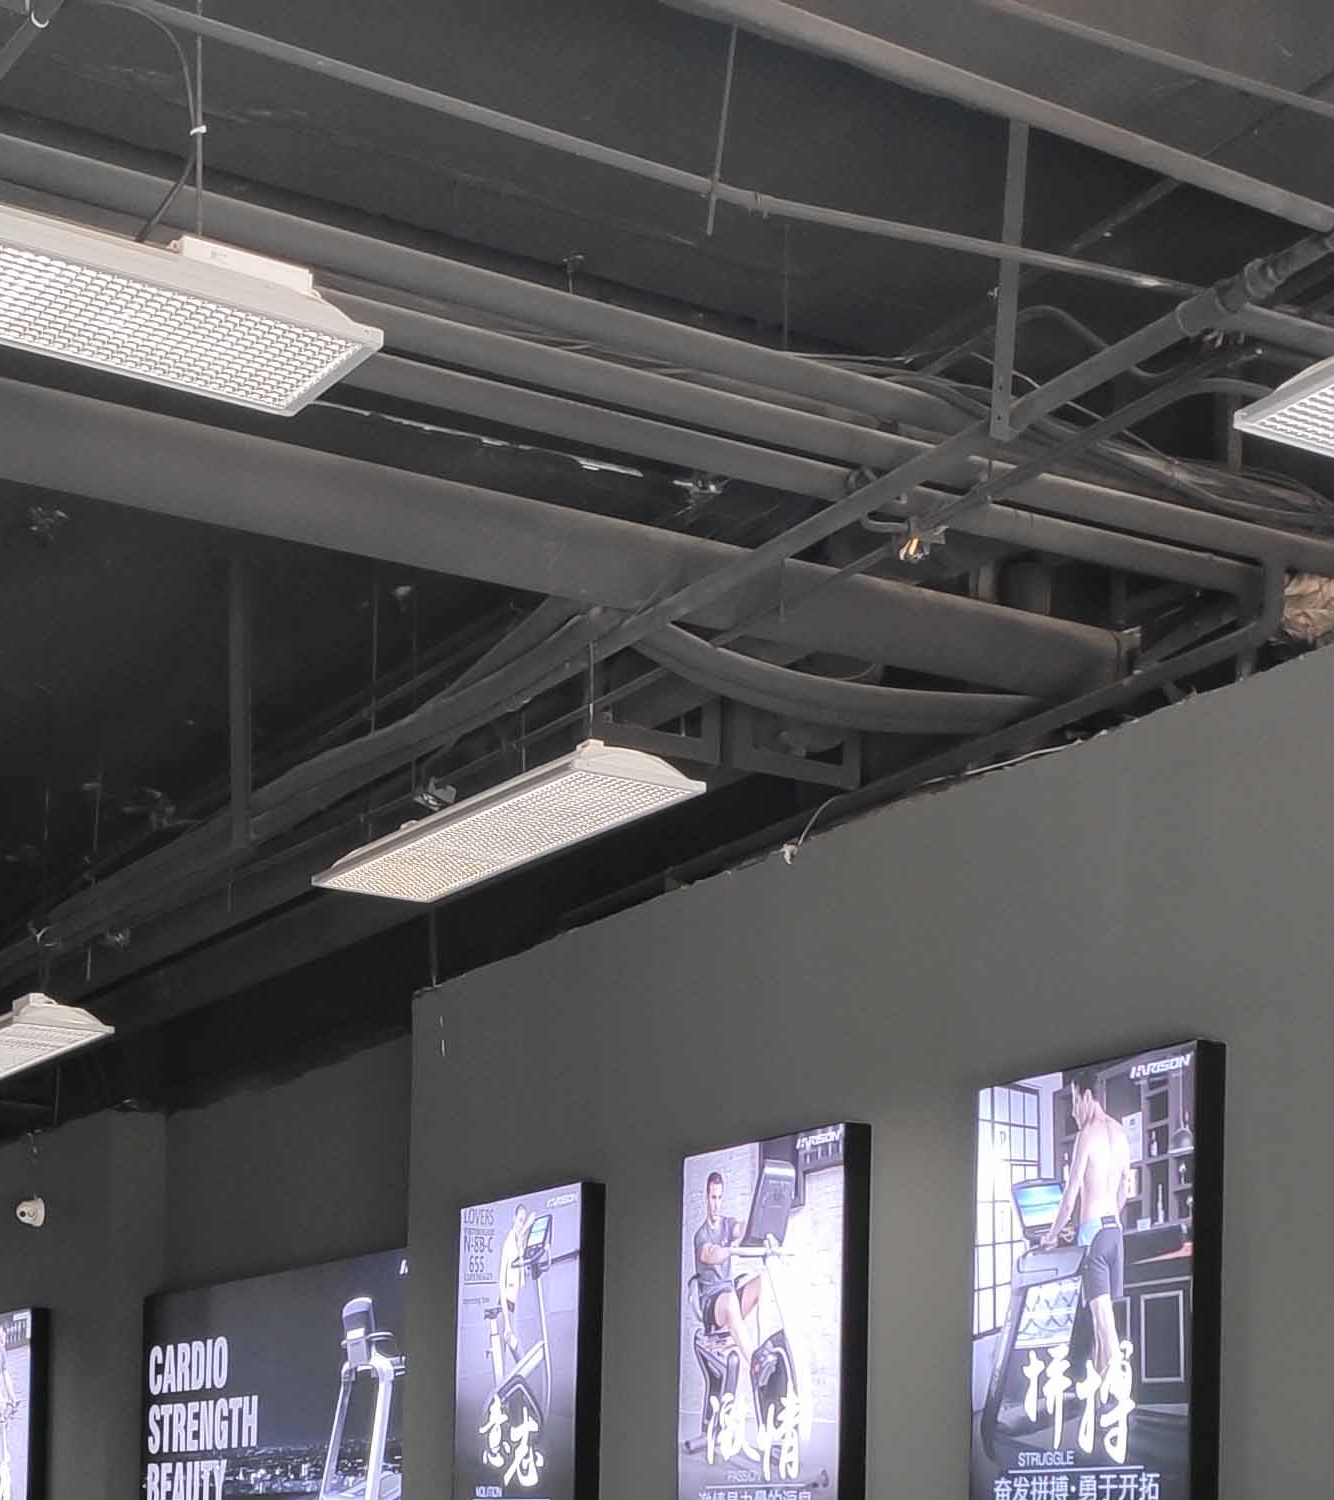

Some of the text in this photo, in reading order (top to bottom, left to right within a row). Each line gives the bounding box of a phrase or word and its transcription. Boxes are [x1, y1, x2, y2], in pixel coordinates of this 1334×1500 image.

[148, 1336, 229, 1396] CARDIO
[1023, 1339, 1135, 1465] 拼搏
[147, 1394, 259, 1455] STRENGTH
[478, 1393, 545, 1487] 意志
[707, 1384, 801, 1482] 激情
[1017, 1451, 1075, 1467] STRUGGLE
